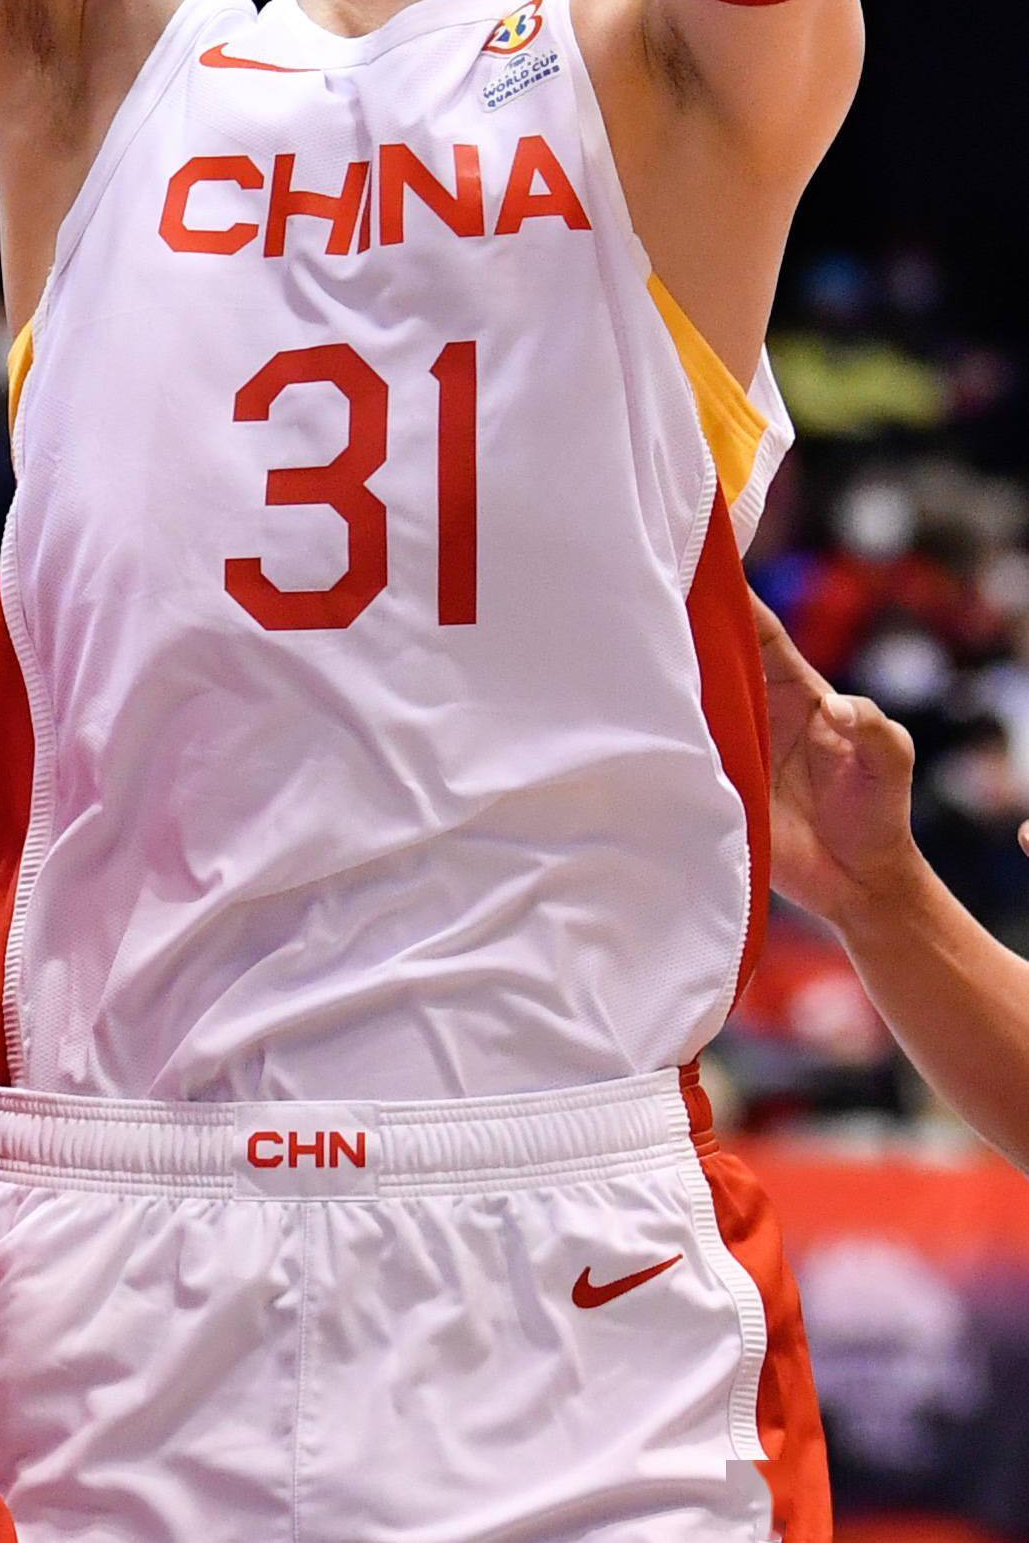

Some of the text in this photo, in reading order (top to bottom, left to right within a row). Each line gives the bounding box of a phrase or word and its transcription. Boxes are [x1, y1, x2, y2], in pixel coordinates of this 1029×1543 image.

[483, 69, 529, 99] WORLD
[532, 53, 559, 72] CUP
[487, 64, 561, 108] QUALIFIERS
[224, 339, 477, 631] 31
[247, 1131, 366, 1168] CHN
